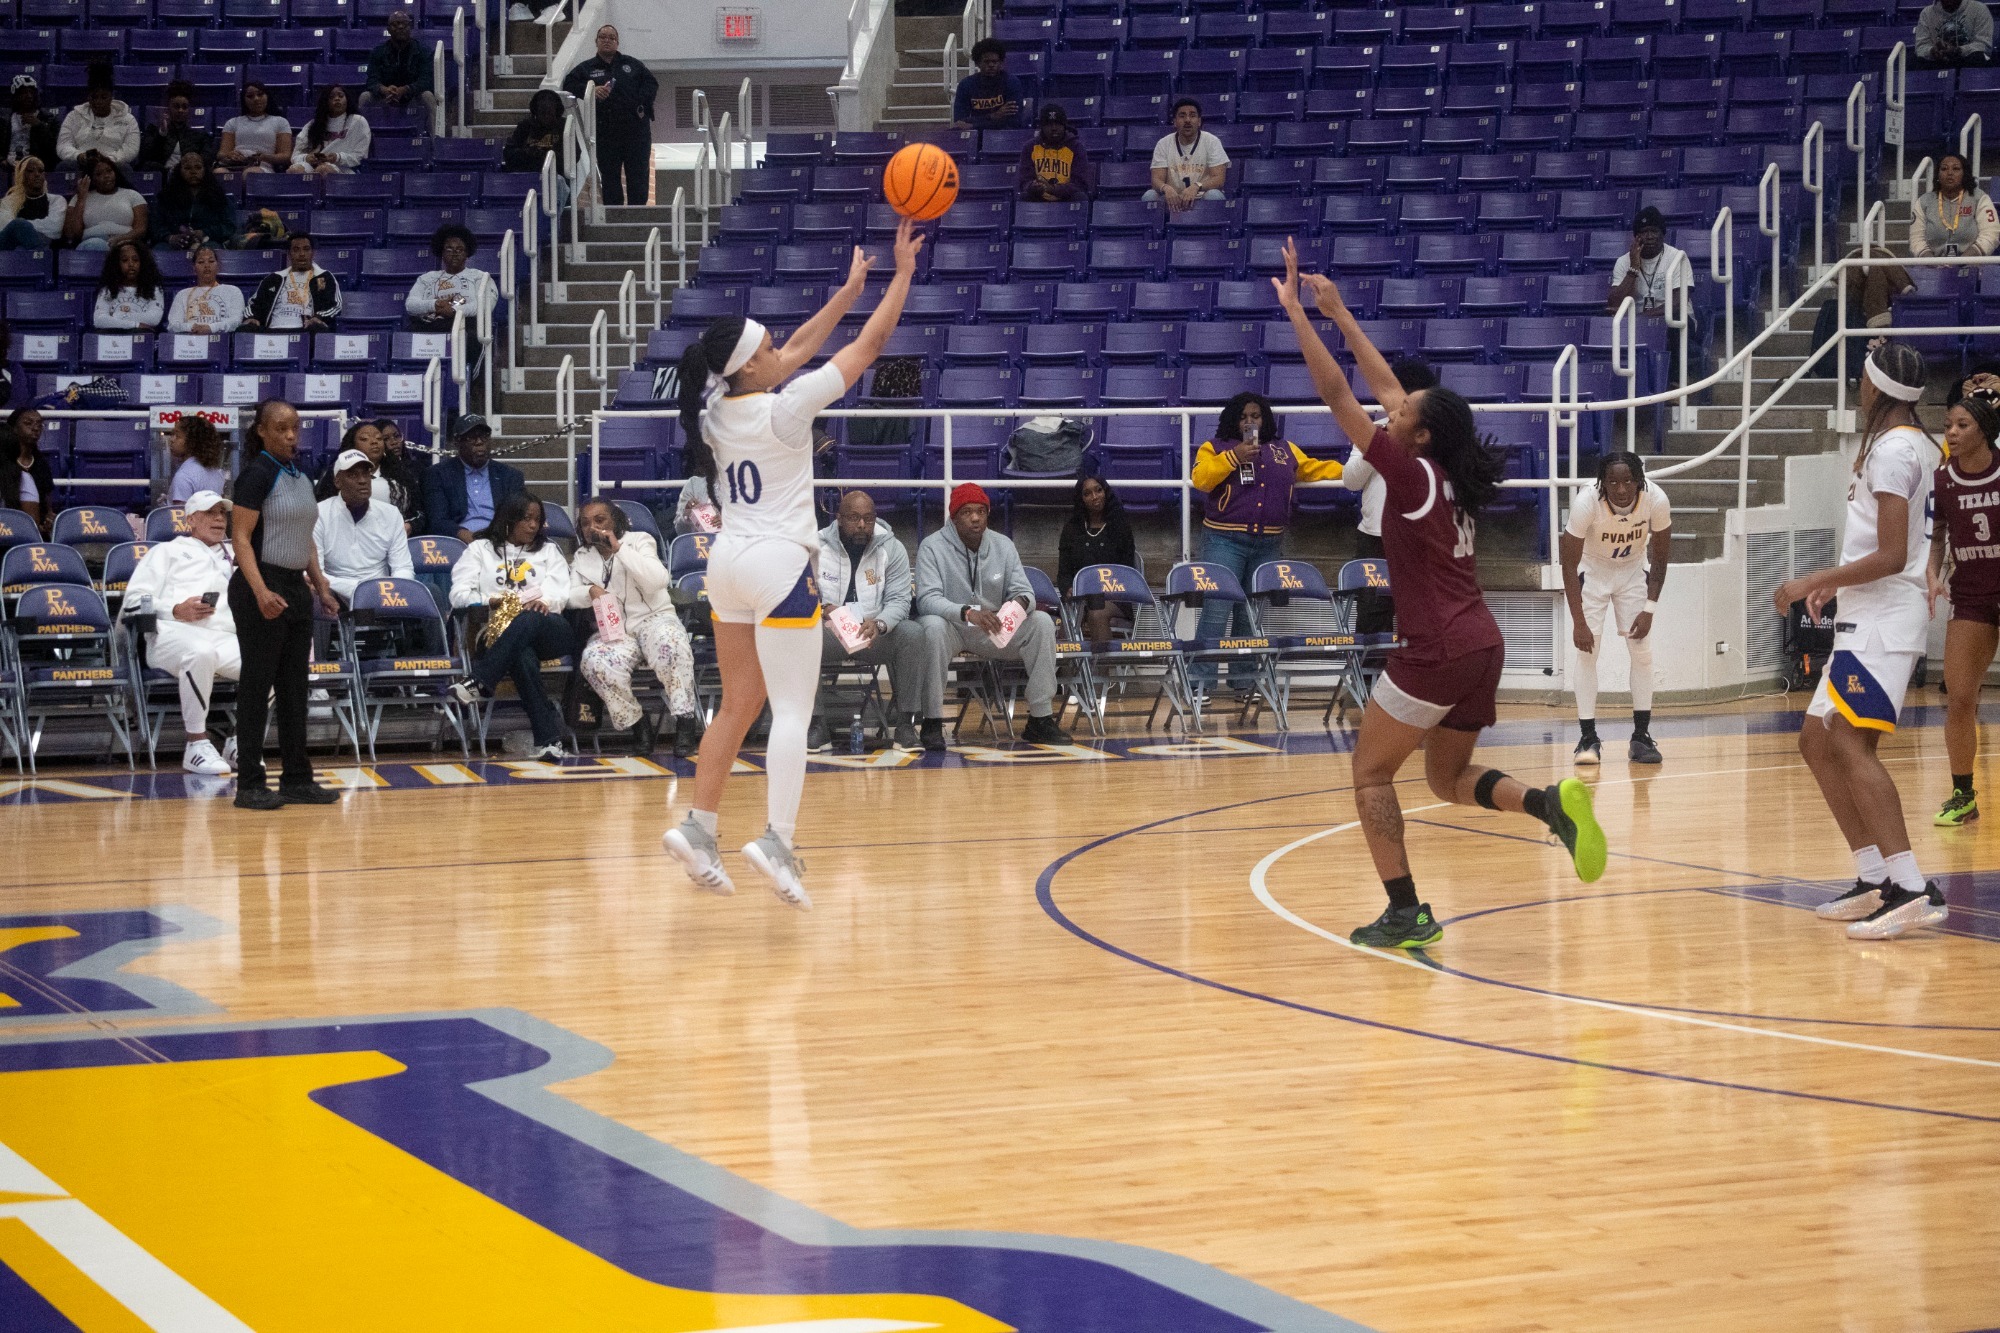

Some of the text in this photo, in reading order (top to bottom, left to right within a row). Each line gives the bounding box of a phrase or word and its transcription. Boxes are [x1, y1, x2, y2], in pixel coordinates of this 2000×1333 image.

[725, 15, 753, 37] EXIT
[1985, 209, 1995, 222] 3
[725, 460, 762, 504] 10
[1958, 491, 2000, 509] TEXAS
[1972, 512, 1991, 542] 3
[1601, 529, 1642, 544] PVAMU
[1611, 544, 1632, 558] 14
[37, 624, 95, 634] PANTHERS
[1121, 641, 1172, 652] PANTHERS
[1219, 638, 1269, 649] PANTHERS
[1305, 635, 1355, 646] PANTHERS
[394, 660, 452, 671] PANTHERS
[53, 669, 114, 681] PANTHERS
